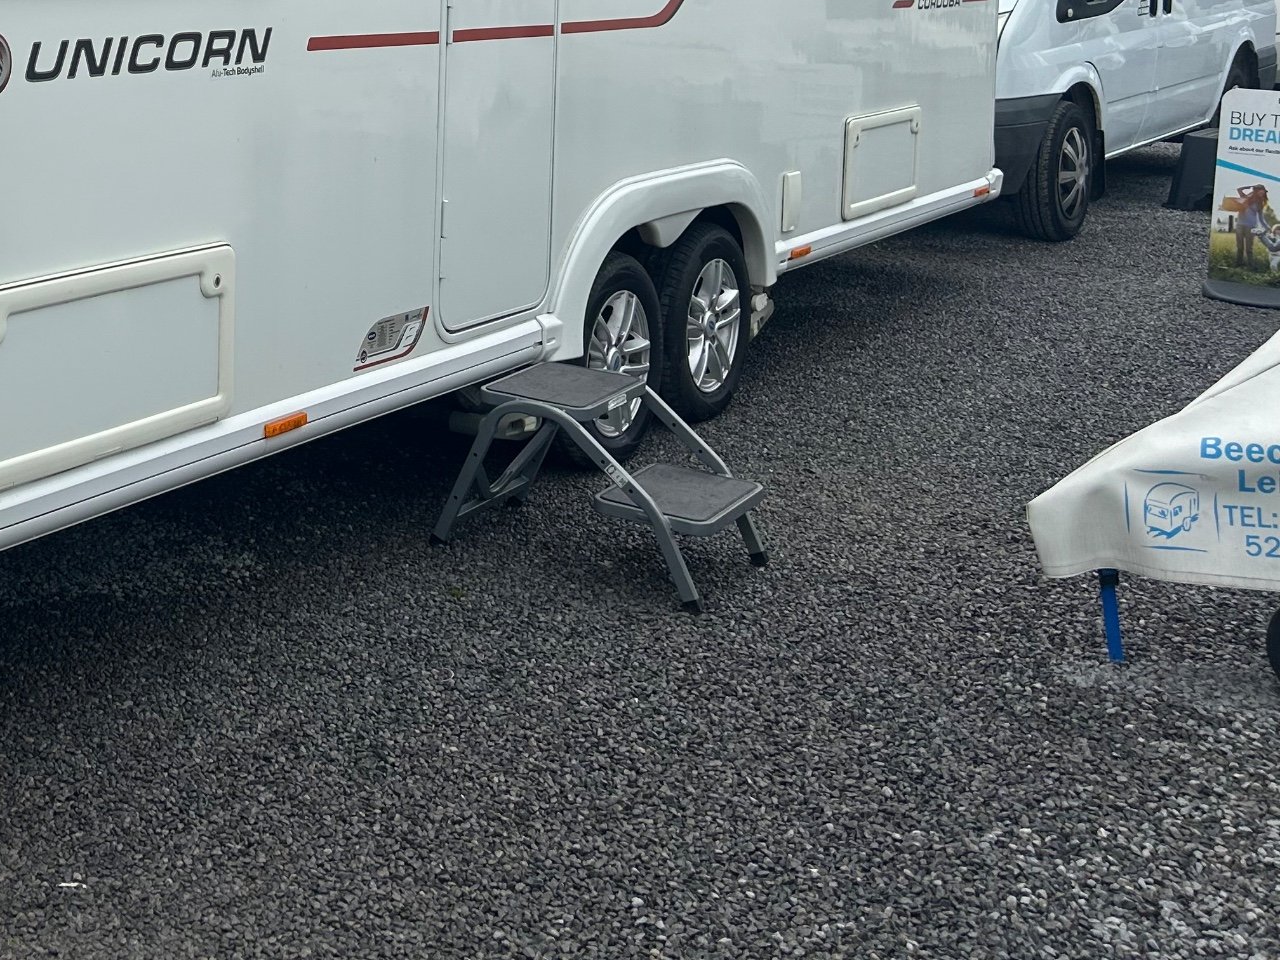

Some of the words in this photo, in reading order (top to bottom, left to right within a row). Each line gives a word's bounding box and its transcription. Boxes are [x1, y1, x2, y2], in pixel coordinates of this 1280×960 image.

[24, 26, 272, 83] UNICORN
[236, 64, 265, 76] Bodyshell
[1230, 111, 1266, 127] BUY
[1229, 126, 1280, 145] DREA
[1238, 469, 1280, 494] Le
[1222, 505, 1278, 529] TEL:
[1245, 534, 1280, 558] 52
